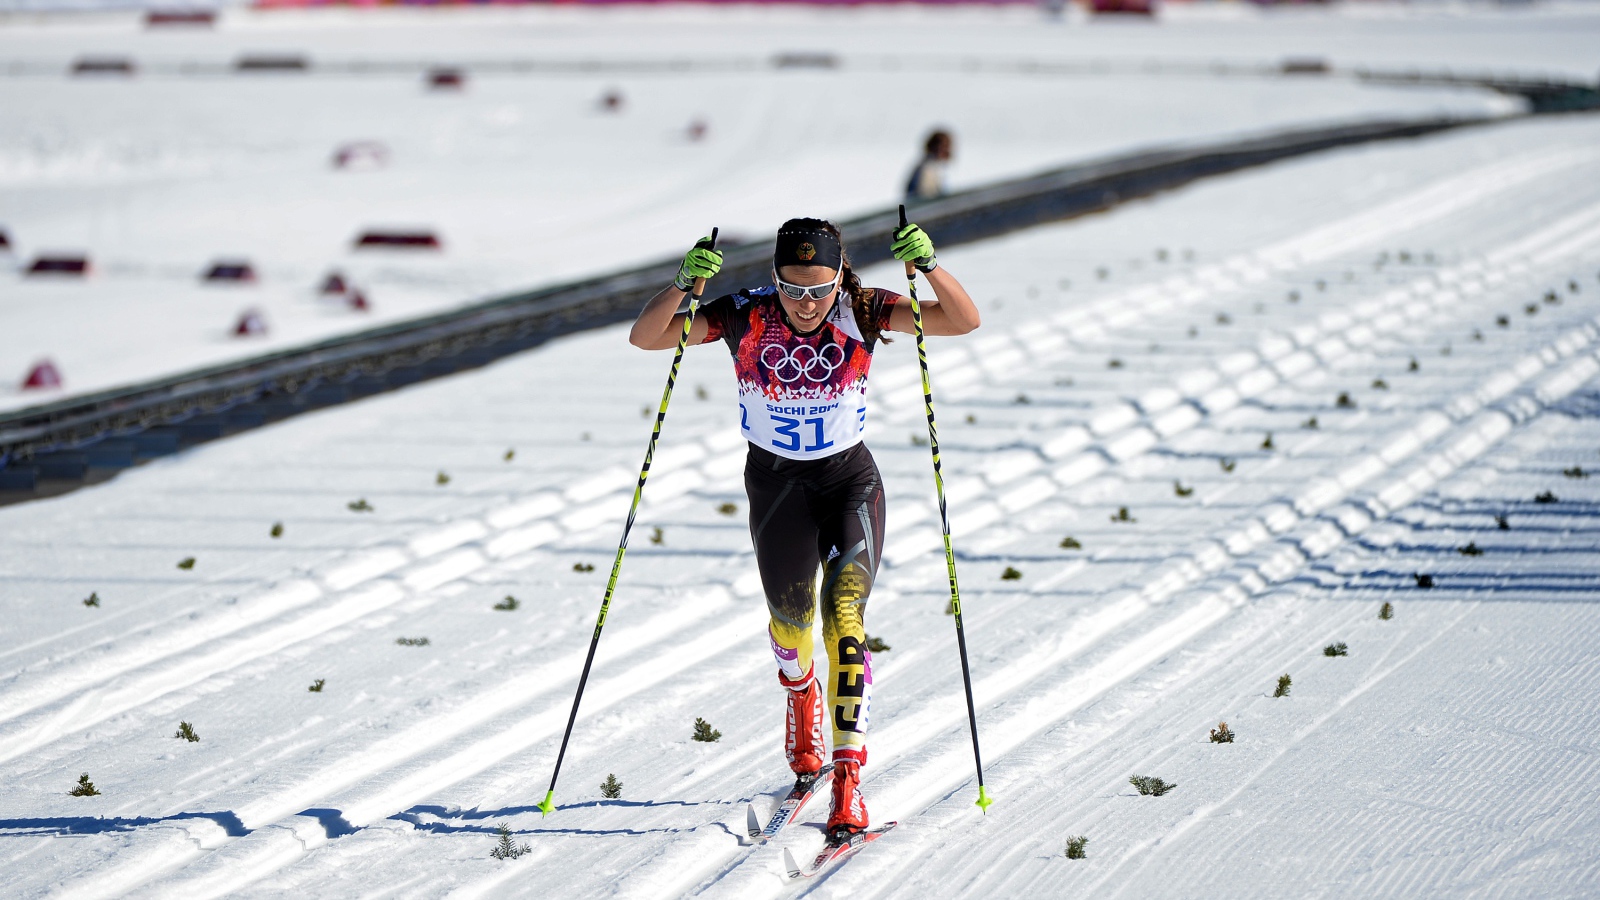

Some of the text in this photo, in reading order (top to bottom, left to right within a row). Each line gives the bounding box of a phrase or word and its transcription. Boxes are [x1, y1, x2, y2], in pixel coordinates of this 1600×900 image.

[766, 402, 840, 416] SOCHI 2014
[770, 415, 834, 452] 31
[834, 635, 868, 732] GER
